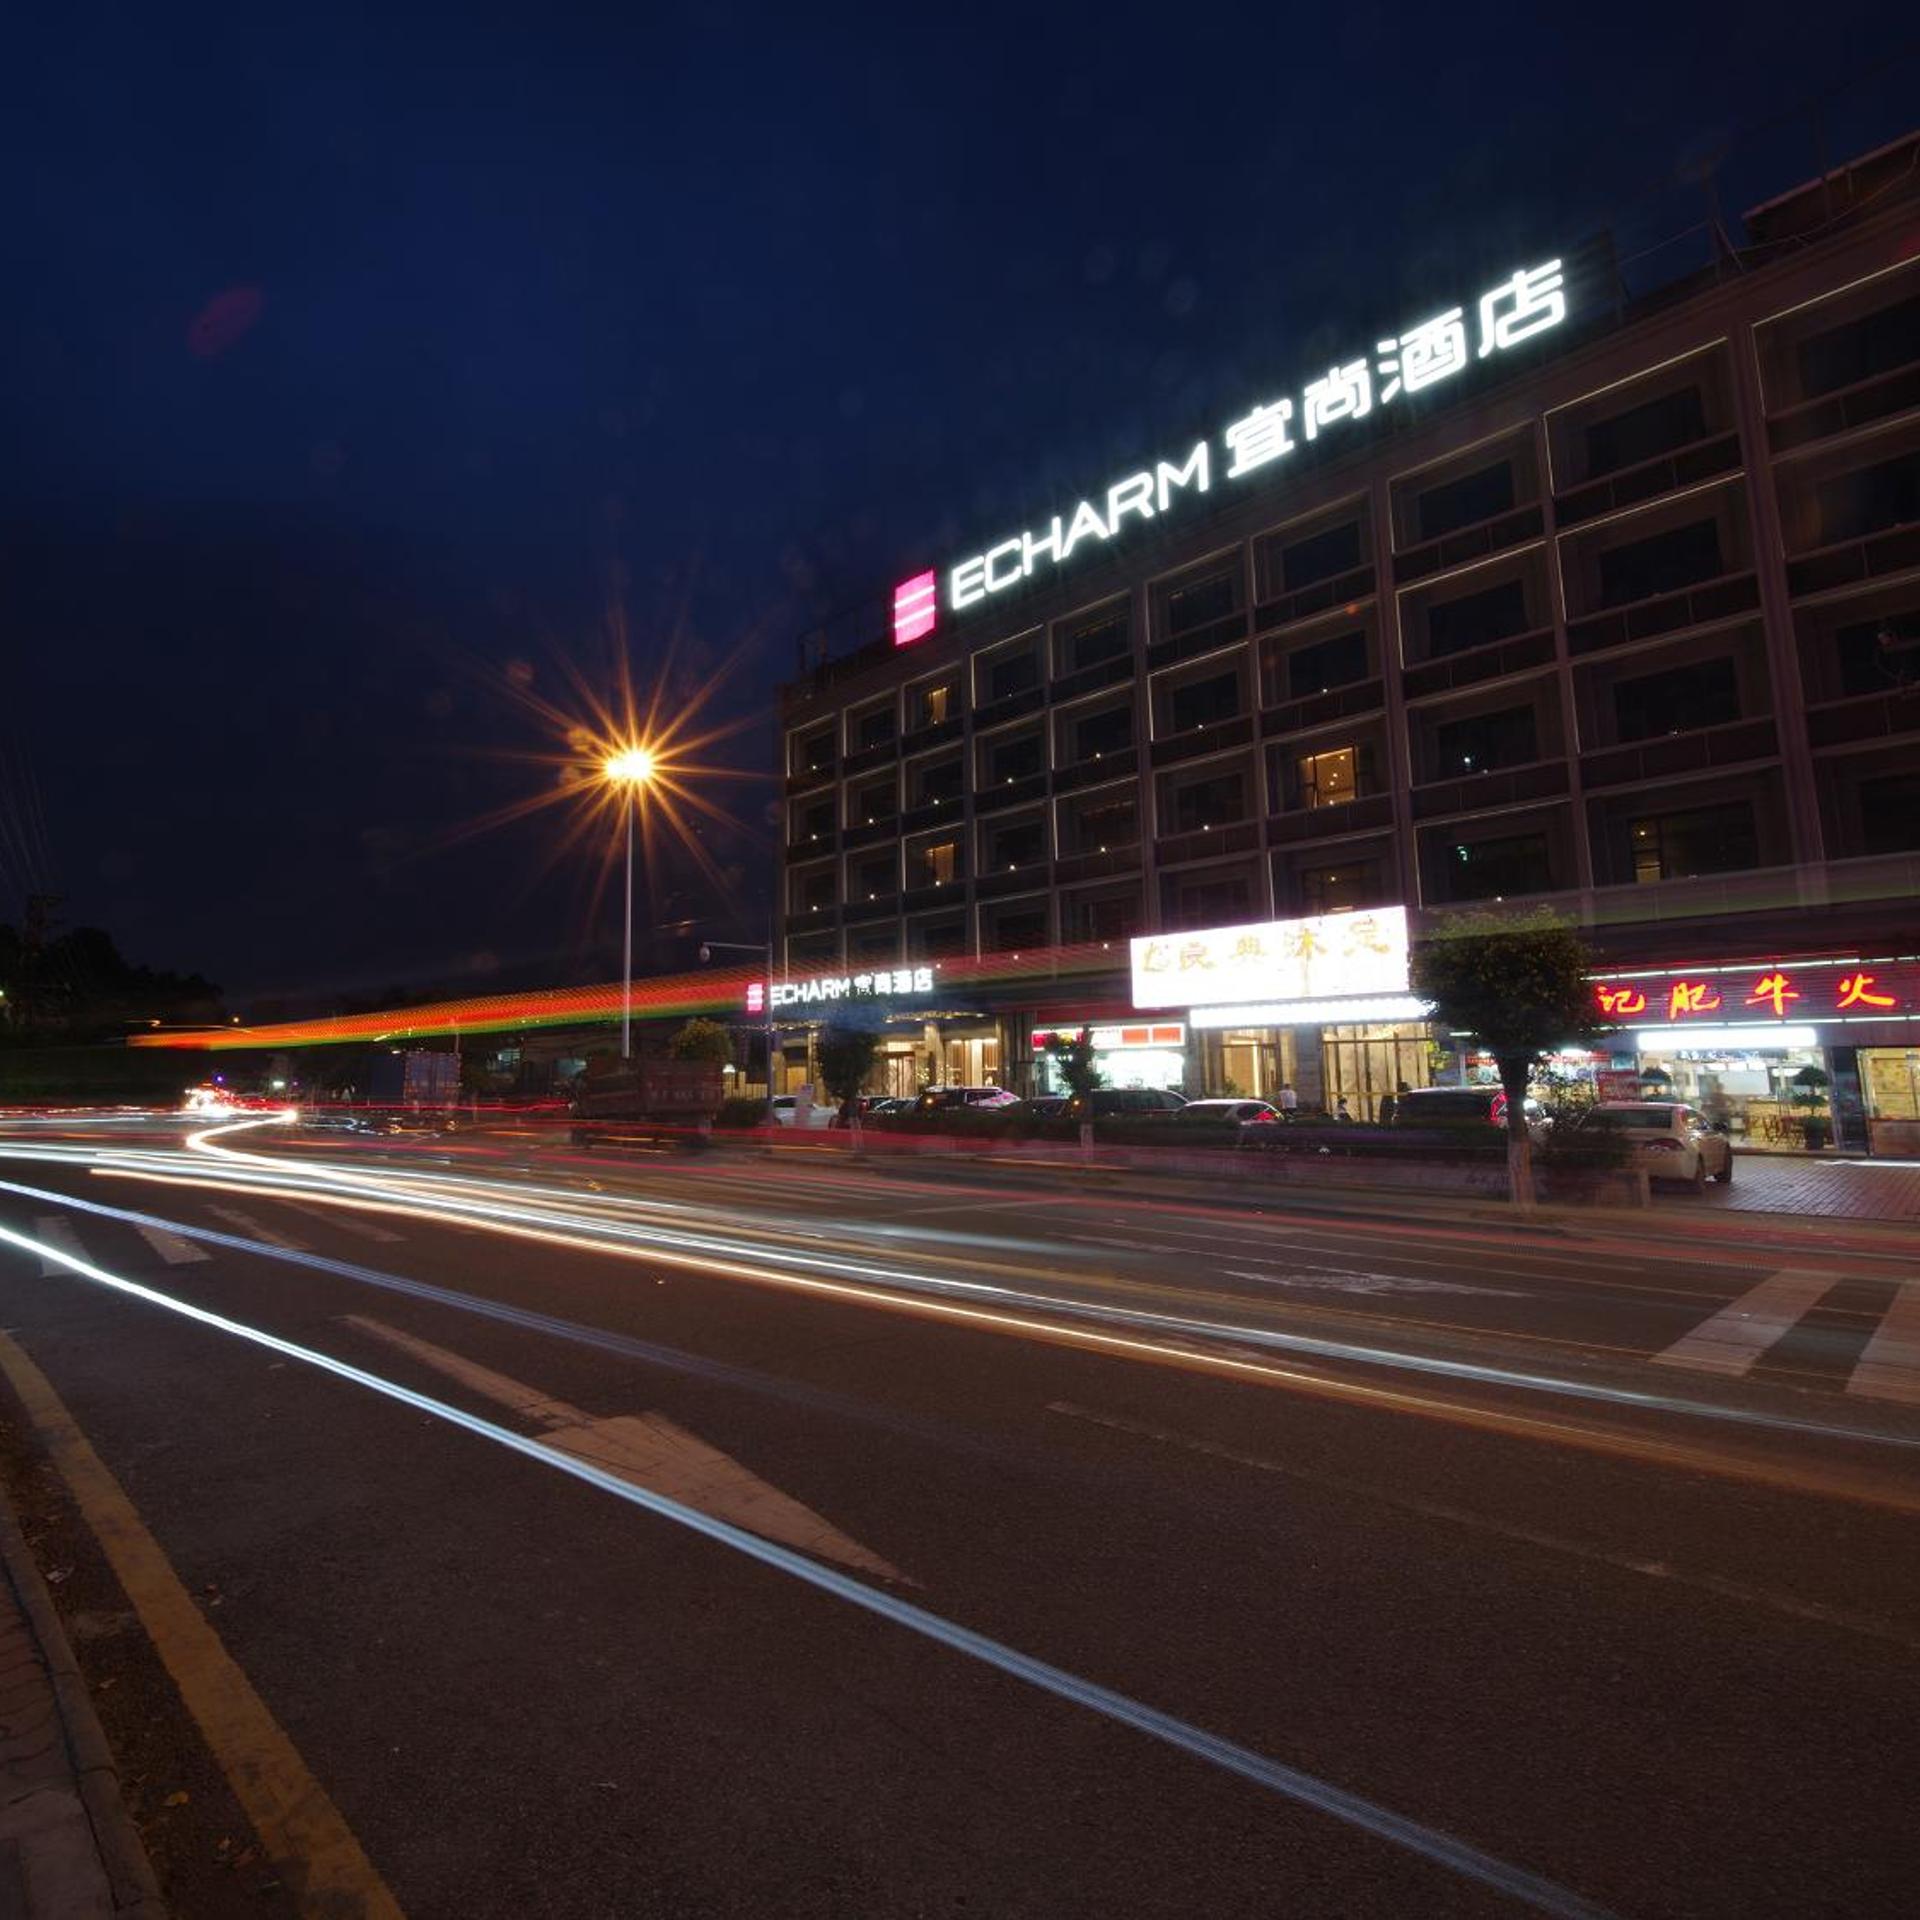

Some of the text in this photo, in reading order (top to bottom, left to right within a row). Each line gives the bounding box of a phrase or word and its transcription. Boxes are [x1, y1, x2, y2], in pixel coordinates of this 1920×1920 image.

[950, 259, 1565, 611] ECHARM 宜尚酒店
[770, 977, 851, 1006] ECHARM
[1597, 973, 1896, 1020] 记肥牛火
